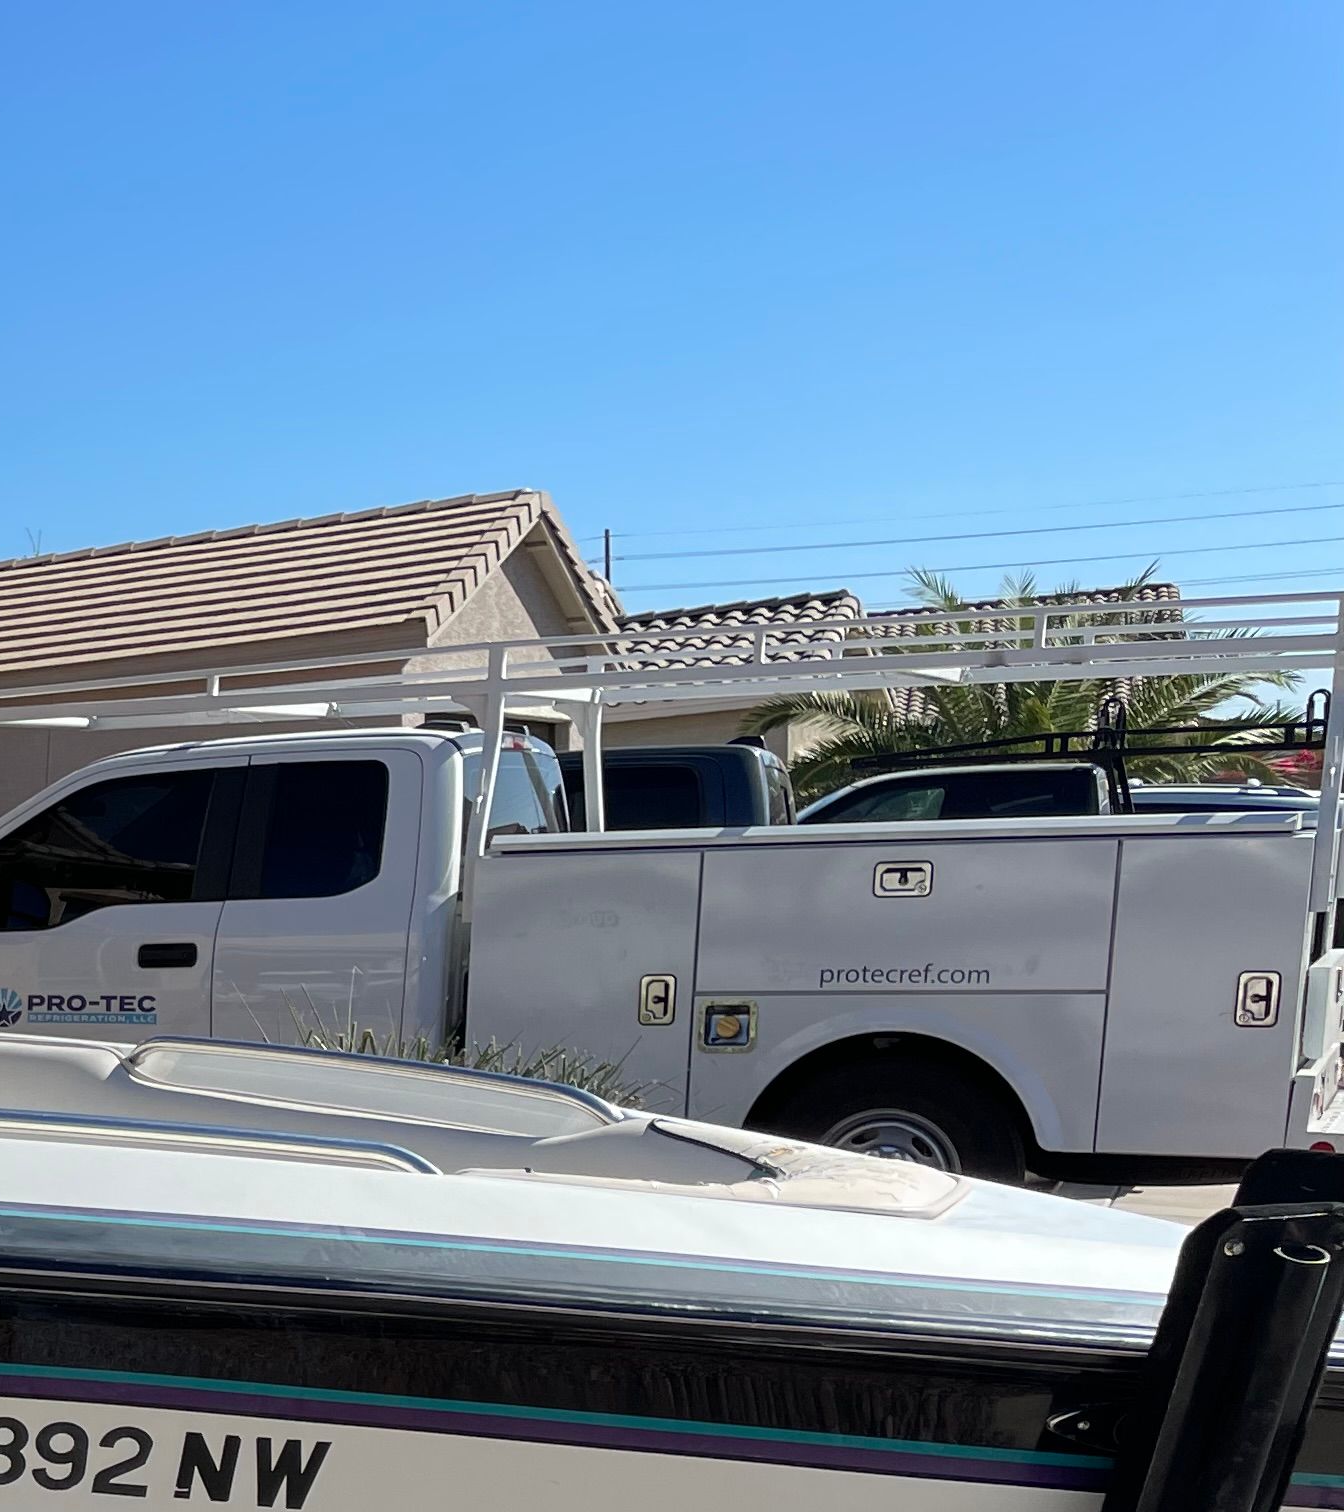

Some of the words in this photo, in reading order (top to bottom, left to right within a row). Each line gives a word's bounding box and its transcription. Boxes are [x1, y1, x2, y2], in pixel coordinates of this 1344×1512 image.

[819, 963, 990, 988] protecref.com
[27, 994, 156, 1012] PRO-TEC
[29, 1014, 130, 1024] REFRIGERATION,
[133, 1014, 156, 1023] LLC
[174, 1431, 333, 1510] NW
